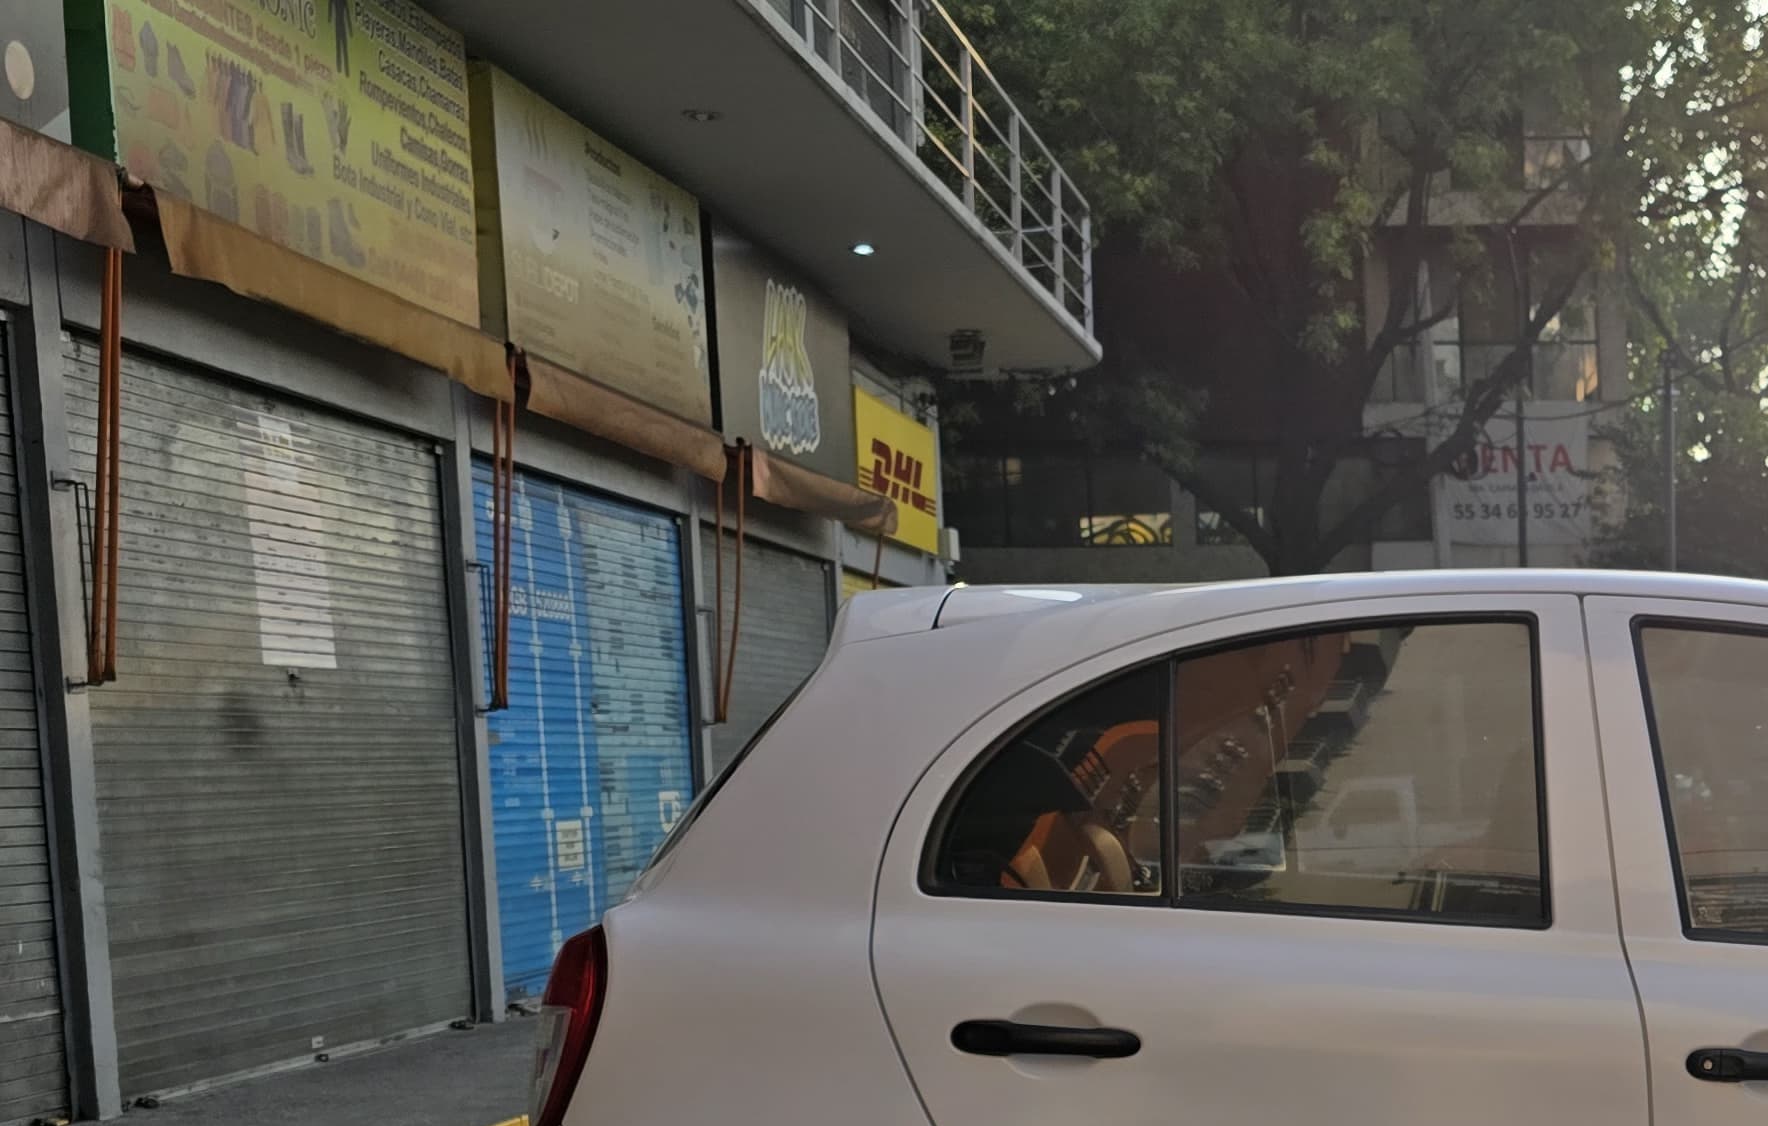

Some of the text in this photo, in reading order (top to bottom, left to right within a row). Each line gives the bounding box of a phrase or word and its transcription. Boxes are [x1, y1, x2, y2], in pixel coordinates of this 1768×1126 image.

[1458, 442, 1575, 473] ENTA
[871, 438, 926, 511] DHL
[1454, 503, 1582, 520] 55 34 6 95 27
